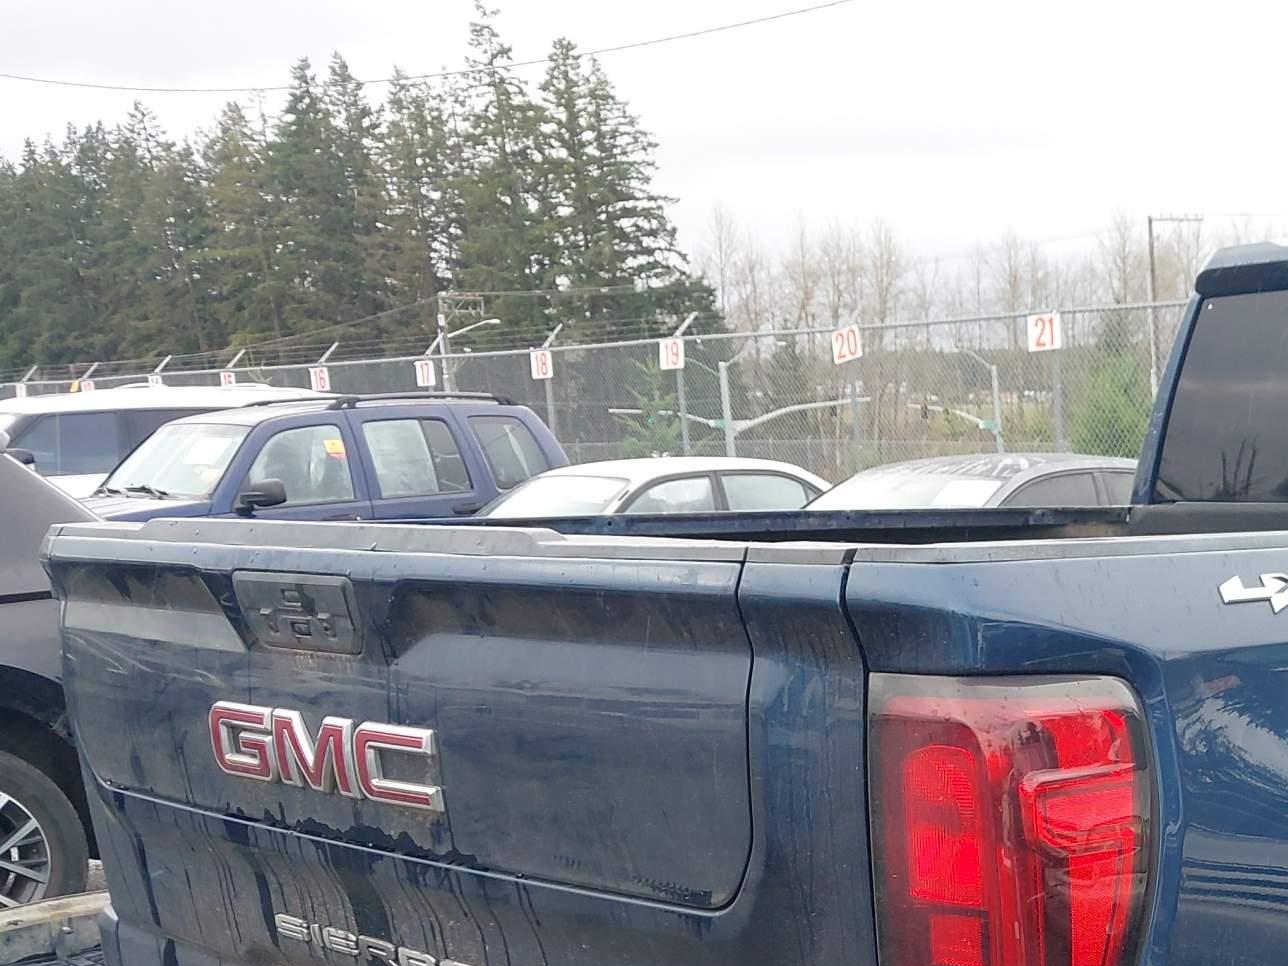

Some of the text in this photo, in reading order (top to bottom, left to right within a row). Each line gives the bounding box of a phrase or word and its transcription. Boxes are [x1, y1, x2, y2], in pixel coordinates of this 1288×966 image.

[834, 329, 858, 360] 20
[1034, 317, 1056, 348] 21
[534, 351, 548, 376] 18
[664, 341, 680, 366] 19
[314, 368, 326, 390] 16
[420, 362, 431, 384] 17
[208, 700, 445, 813] GMC
